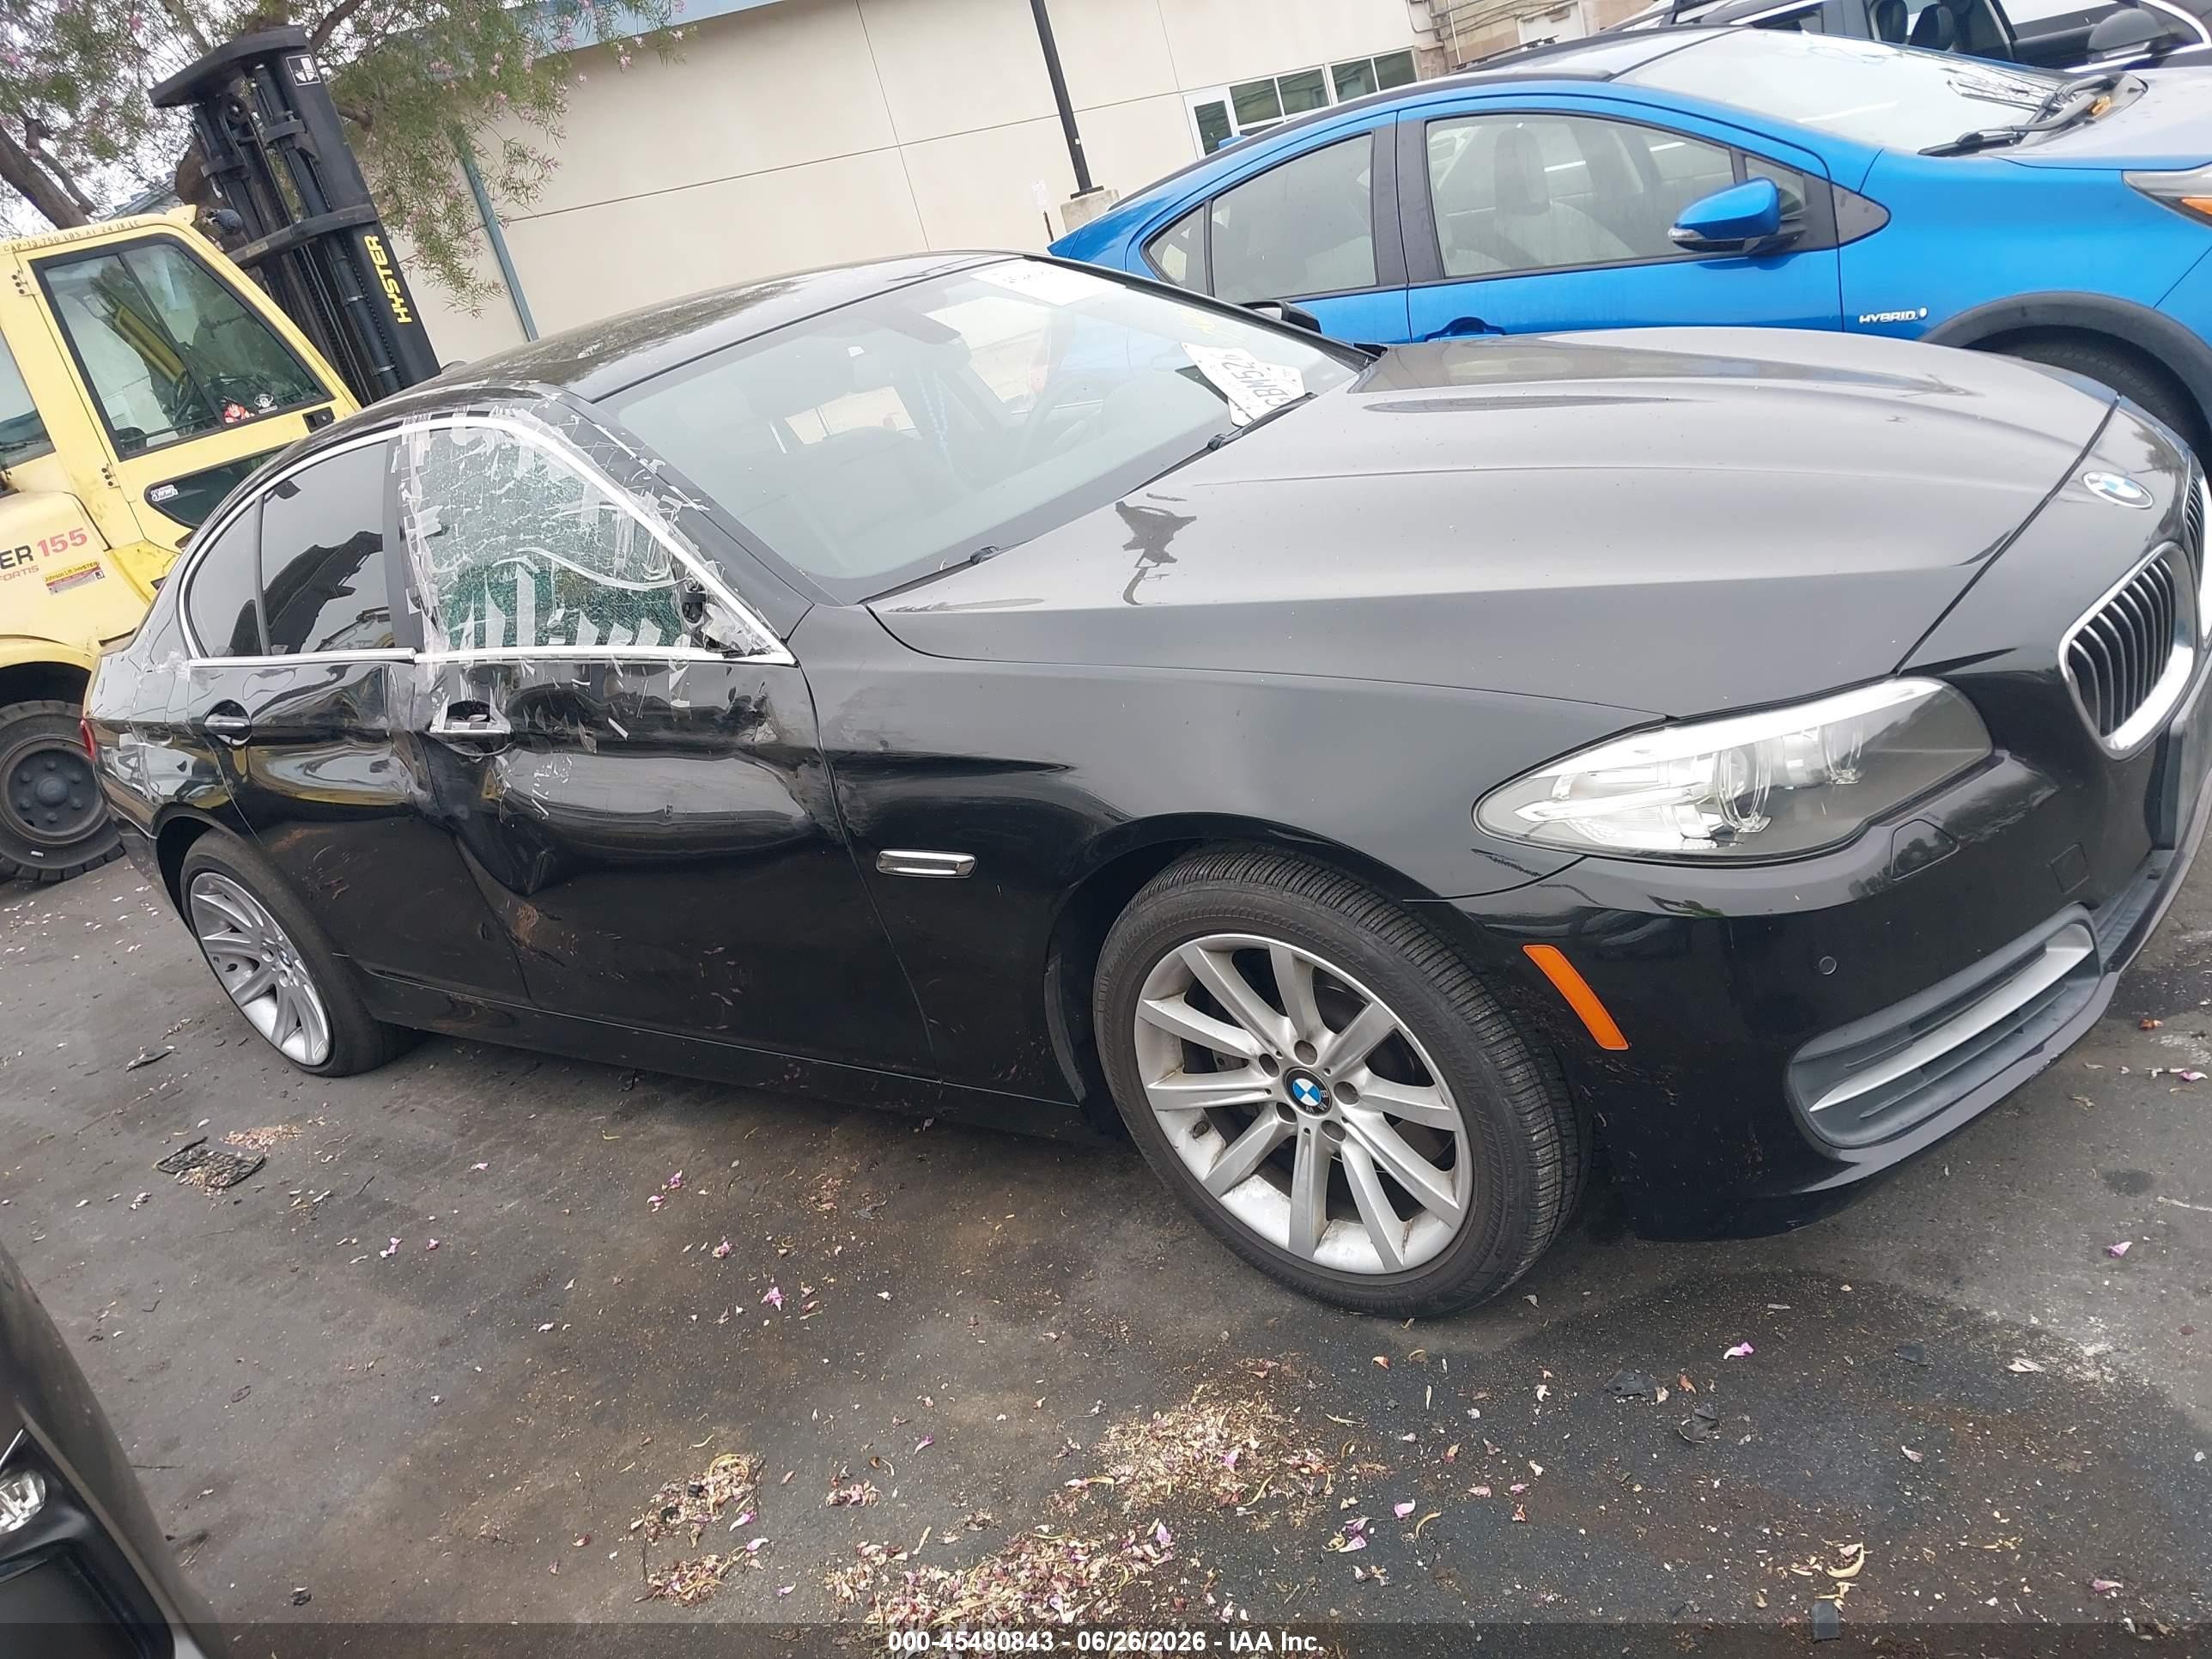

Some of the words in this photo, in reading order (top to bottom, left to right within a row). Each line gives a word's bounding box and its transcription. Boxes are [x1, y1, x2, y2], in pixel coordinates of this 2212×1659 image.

[364, 235, 412, 323] HYSTER
[1859, 310, 1917, 325] HYBRID
[37, 527, 88, 556] 155
